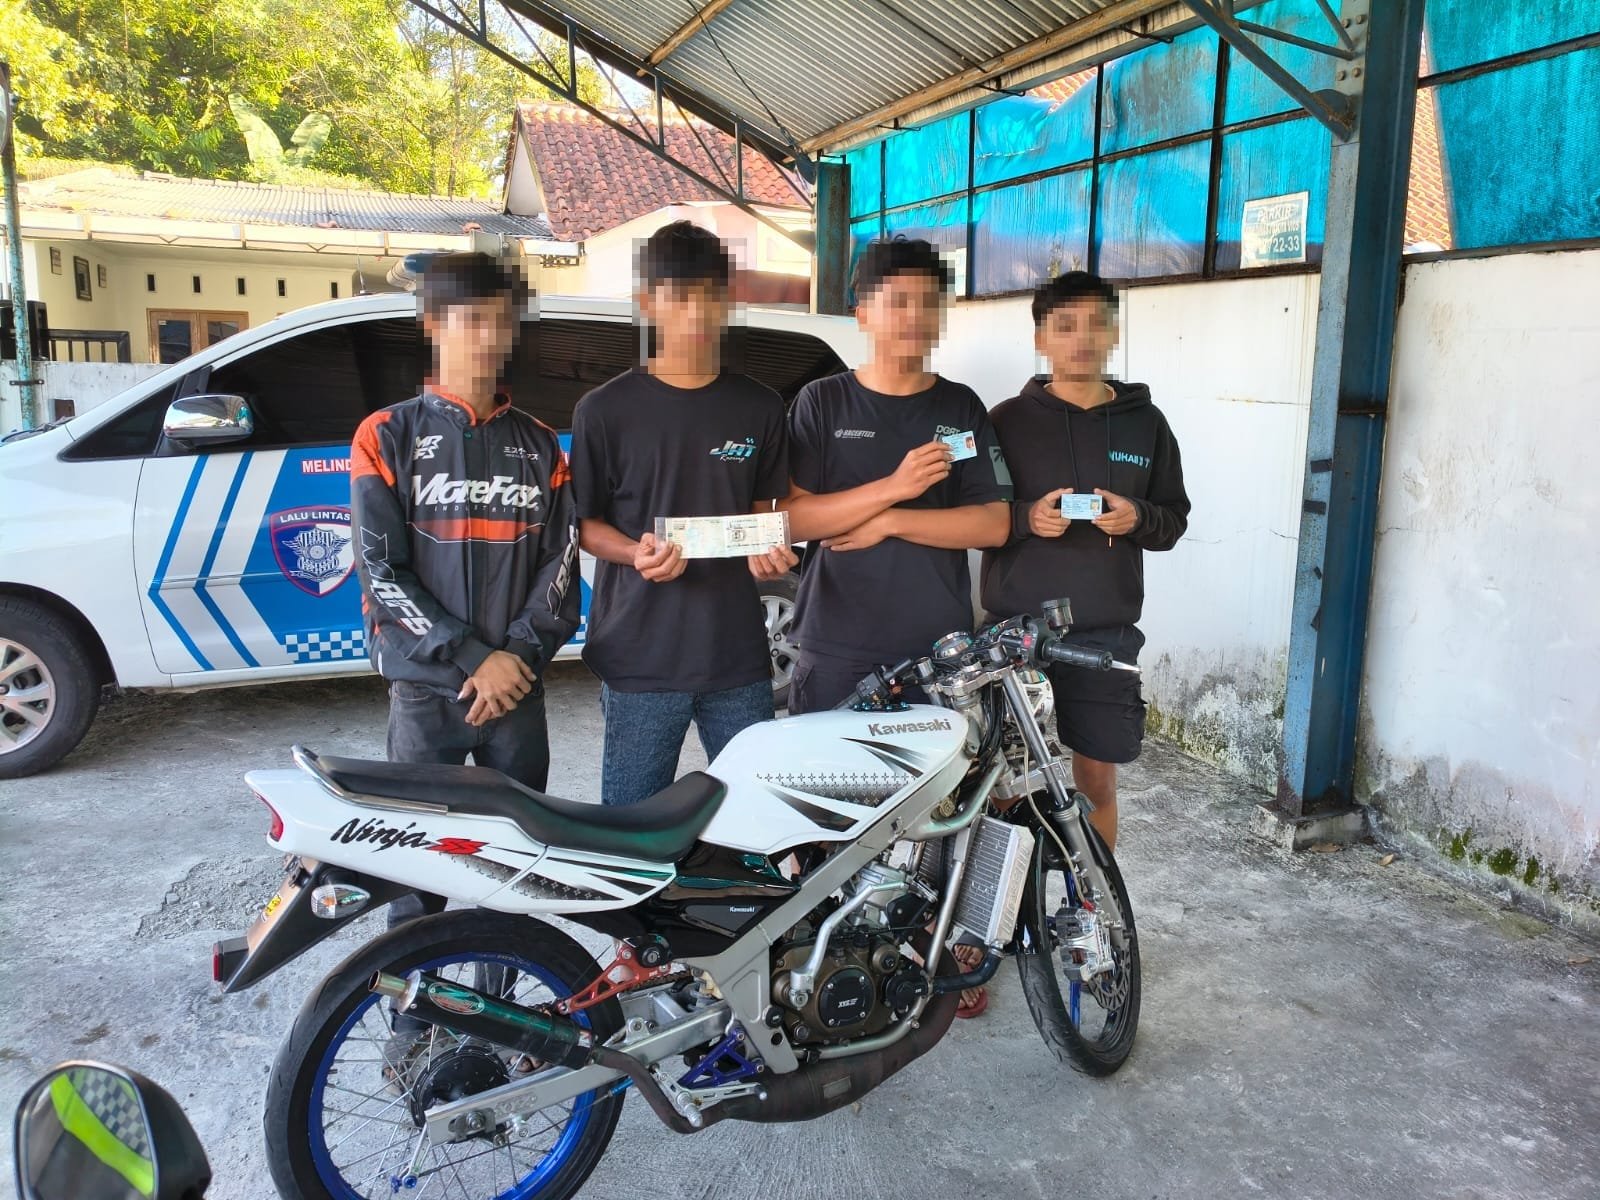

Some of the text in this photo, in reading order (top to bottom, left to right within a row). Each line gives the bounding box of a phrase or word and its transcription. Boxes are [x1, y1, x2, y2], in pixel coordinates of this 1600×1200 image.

[279, 511, 351, 524] LALU LINTAS
[868, 718, 952, 737] Kawasaki
[330, 817, 432, 853] Ninja
